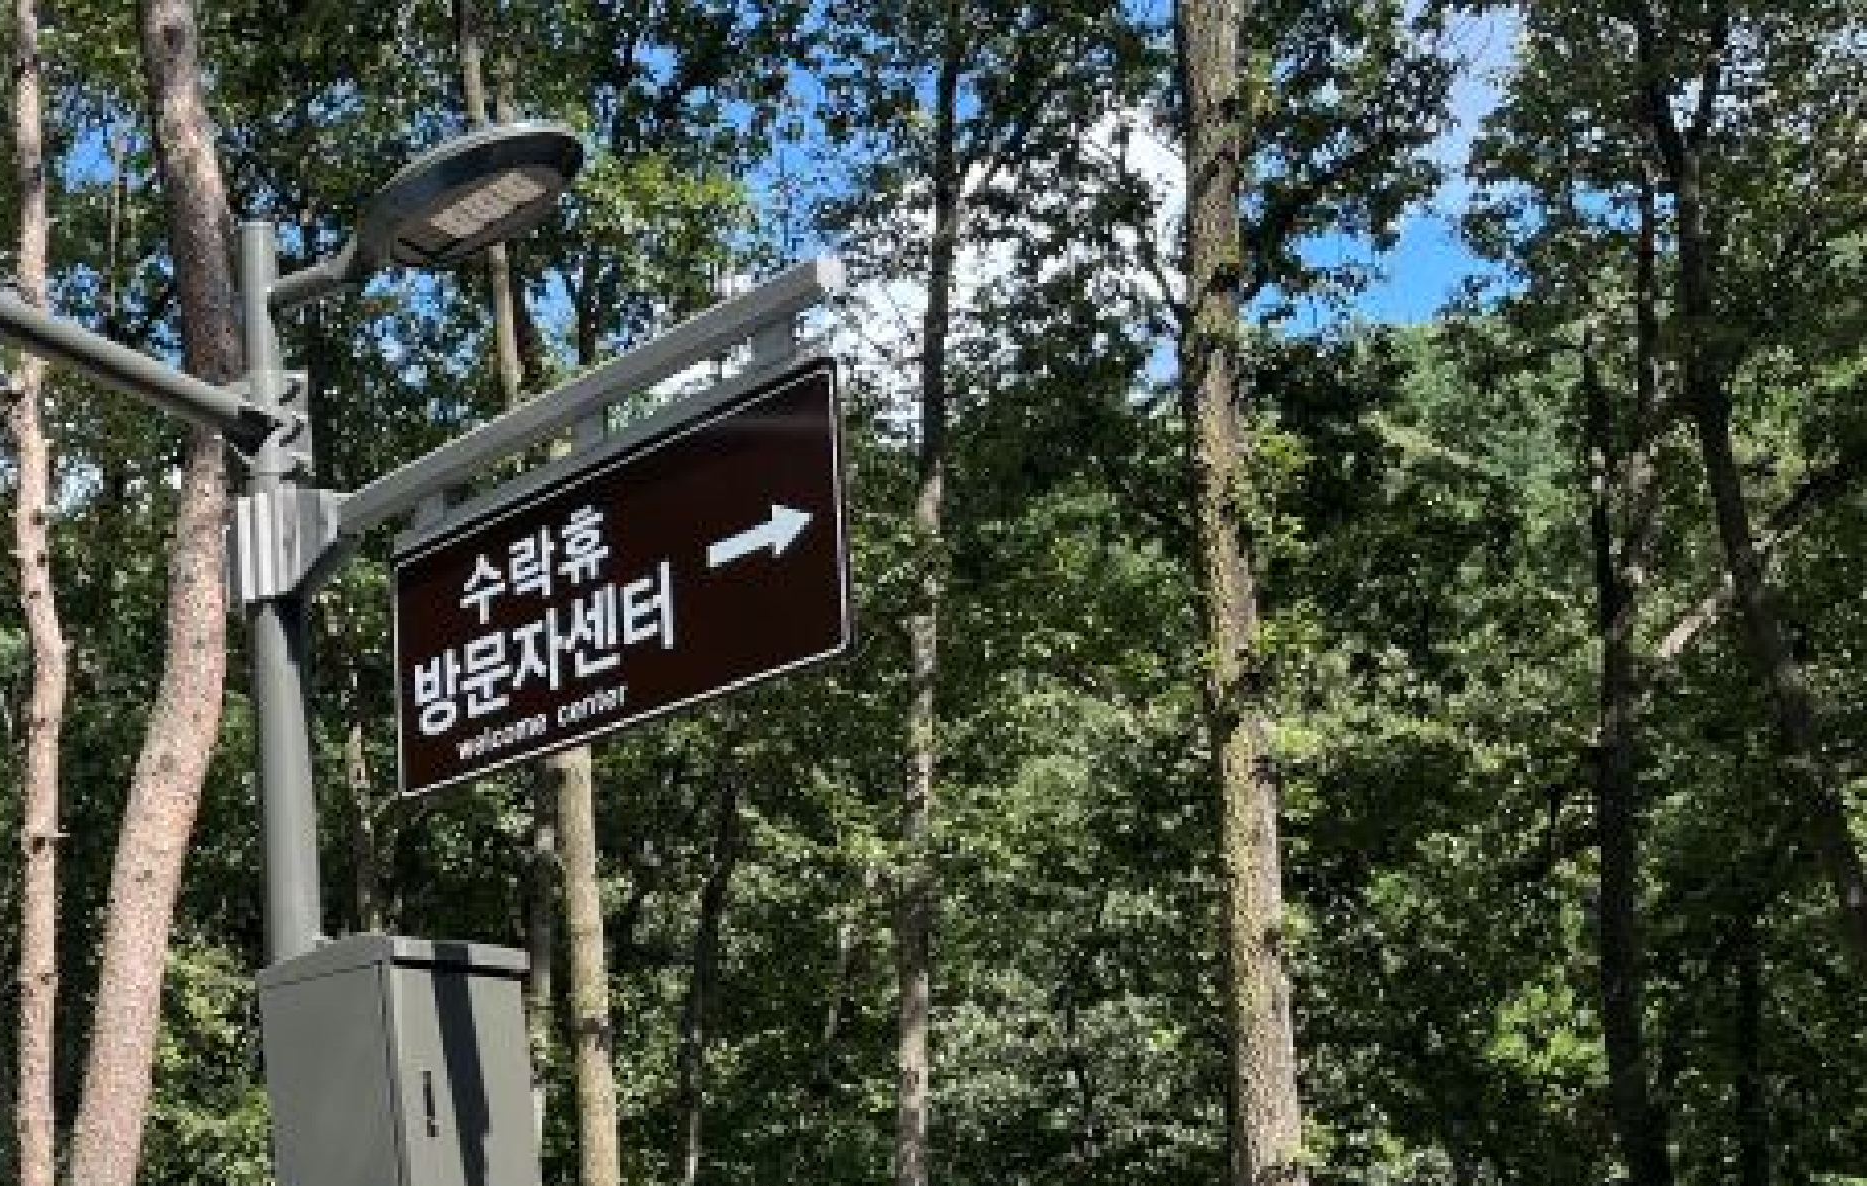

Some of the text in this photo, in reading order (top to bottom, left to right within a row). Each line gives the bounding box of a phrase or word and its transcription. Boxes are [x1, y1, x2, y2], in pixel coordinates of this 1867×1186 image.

[459, 504, 609, 625] 수락휴
[414, 560, 674, 735] 방문자센터
[557, 685, 628, 727] center
